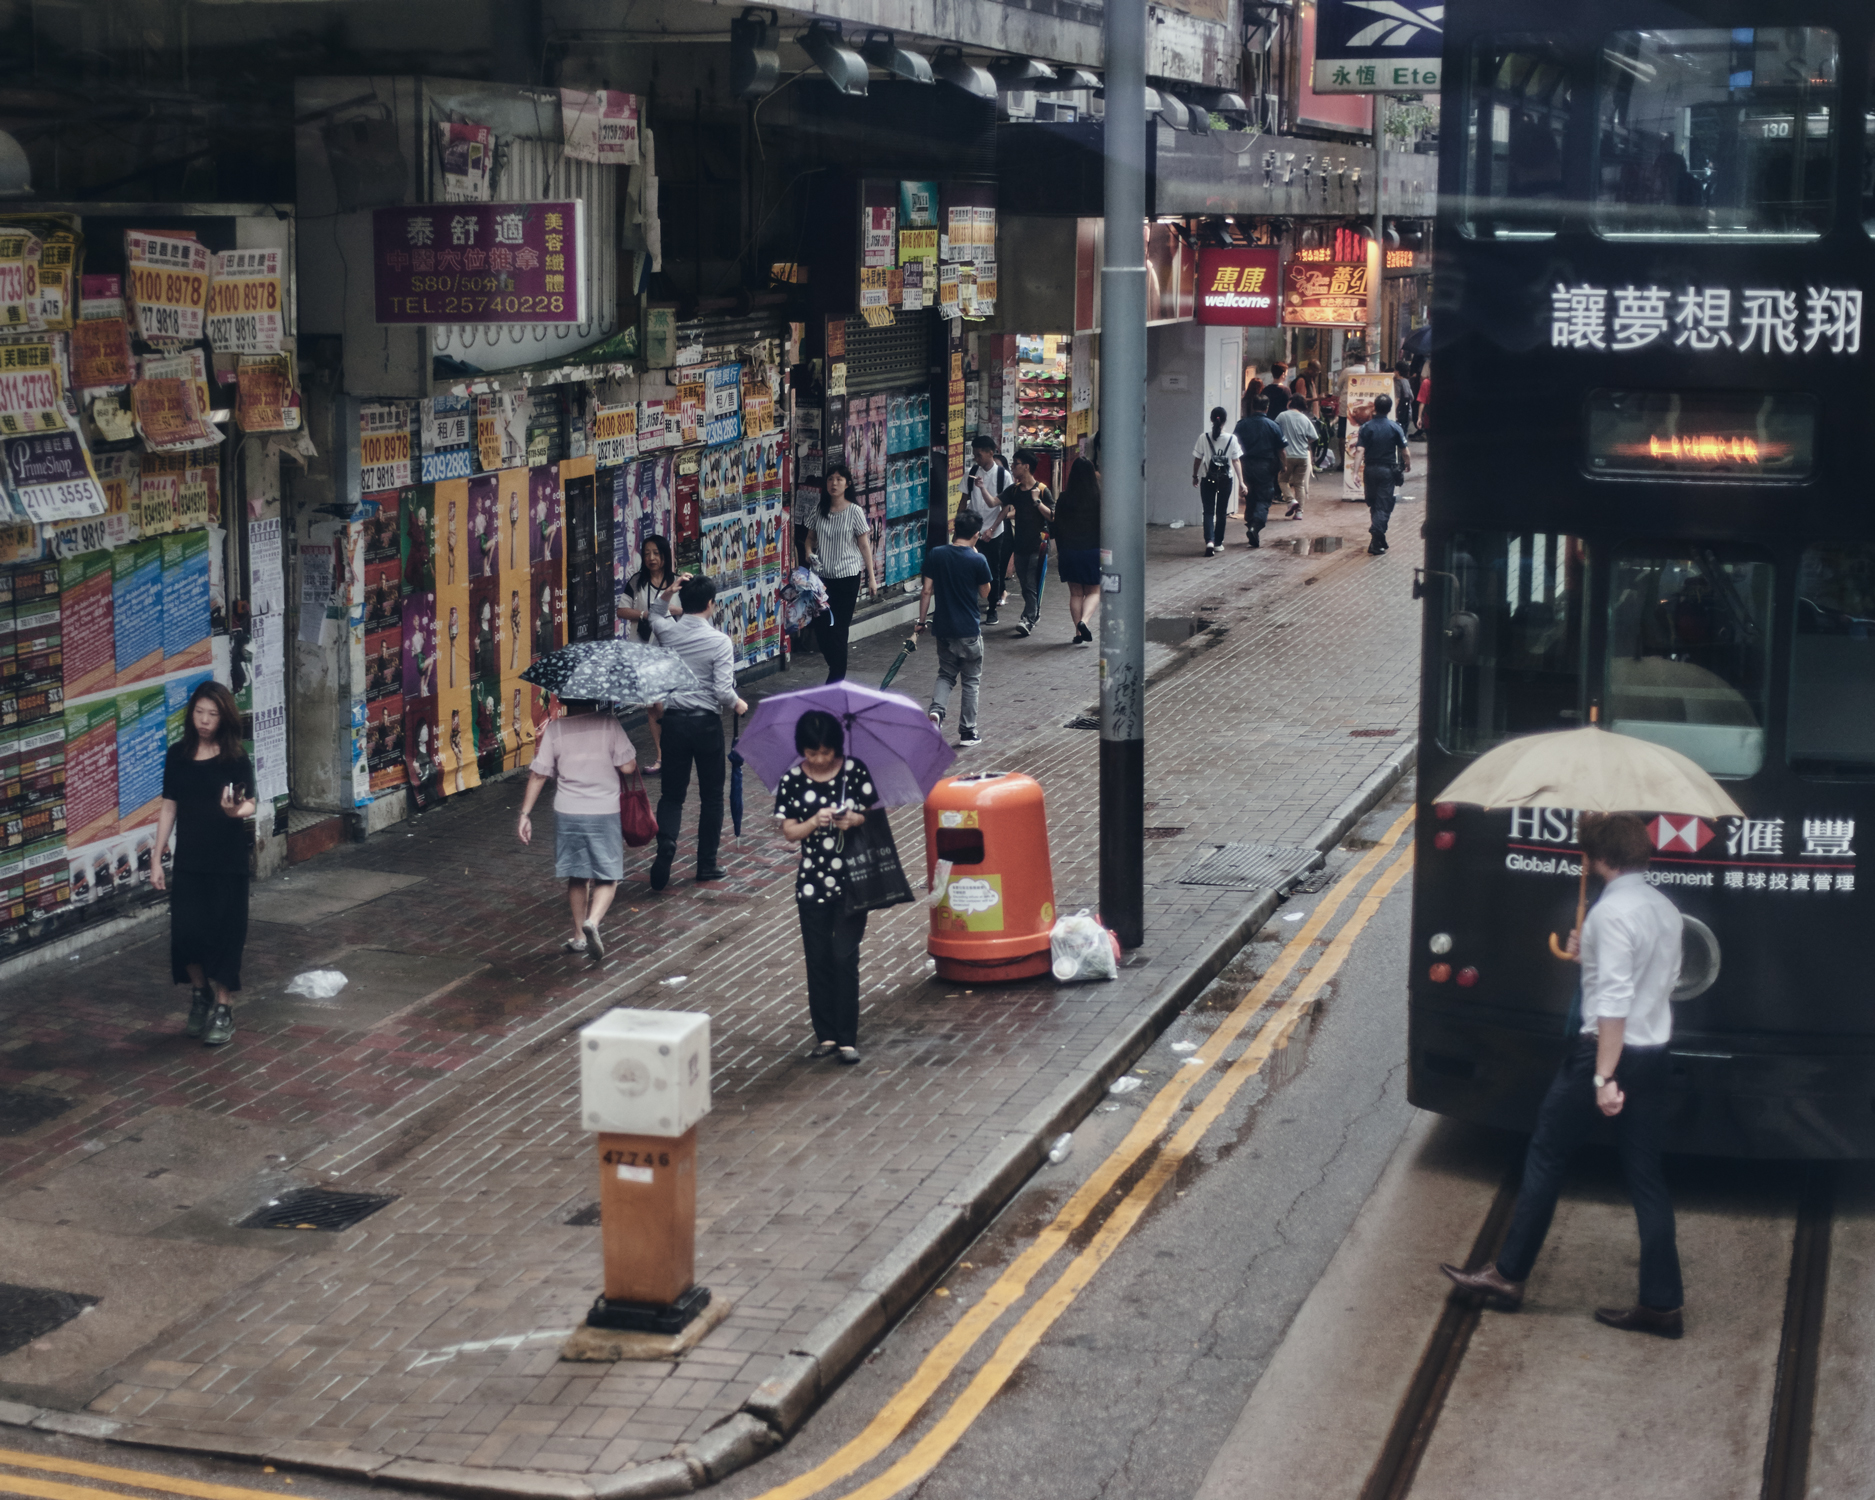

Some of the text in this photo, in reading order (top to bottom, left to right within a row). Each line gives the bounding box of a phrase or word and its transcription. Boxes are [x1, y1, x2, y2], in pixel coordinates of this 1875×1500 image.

[407, 214, 525, 247] 泰舒適
[387, 247, 540, 272] 中醫穴位推拿
[544, 213, 566, 293] 美容纖體
[166, 274, 203, 306] 8978
[1210, 267, 1267, 293] 惠康
[243, 281, 277, 312] 8978
[1204, 293, 1271, 308] wellcome
[235, 316, 256, 342] 9818
[1551, 283, 1863, 355] 讓夢想飛翔
[23, 482, 93, 509] 2111 3555
[1505, 852, 1556, 875] Global
[1725, 871, 1857, 894] 環球投資管理
